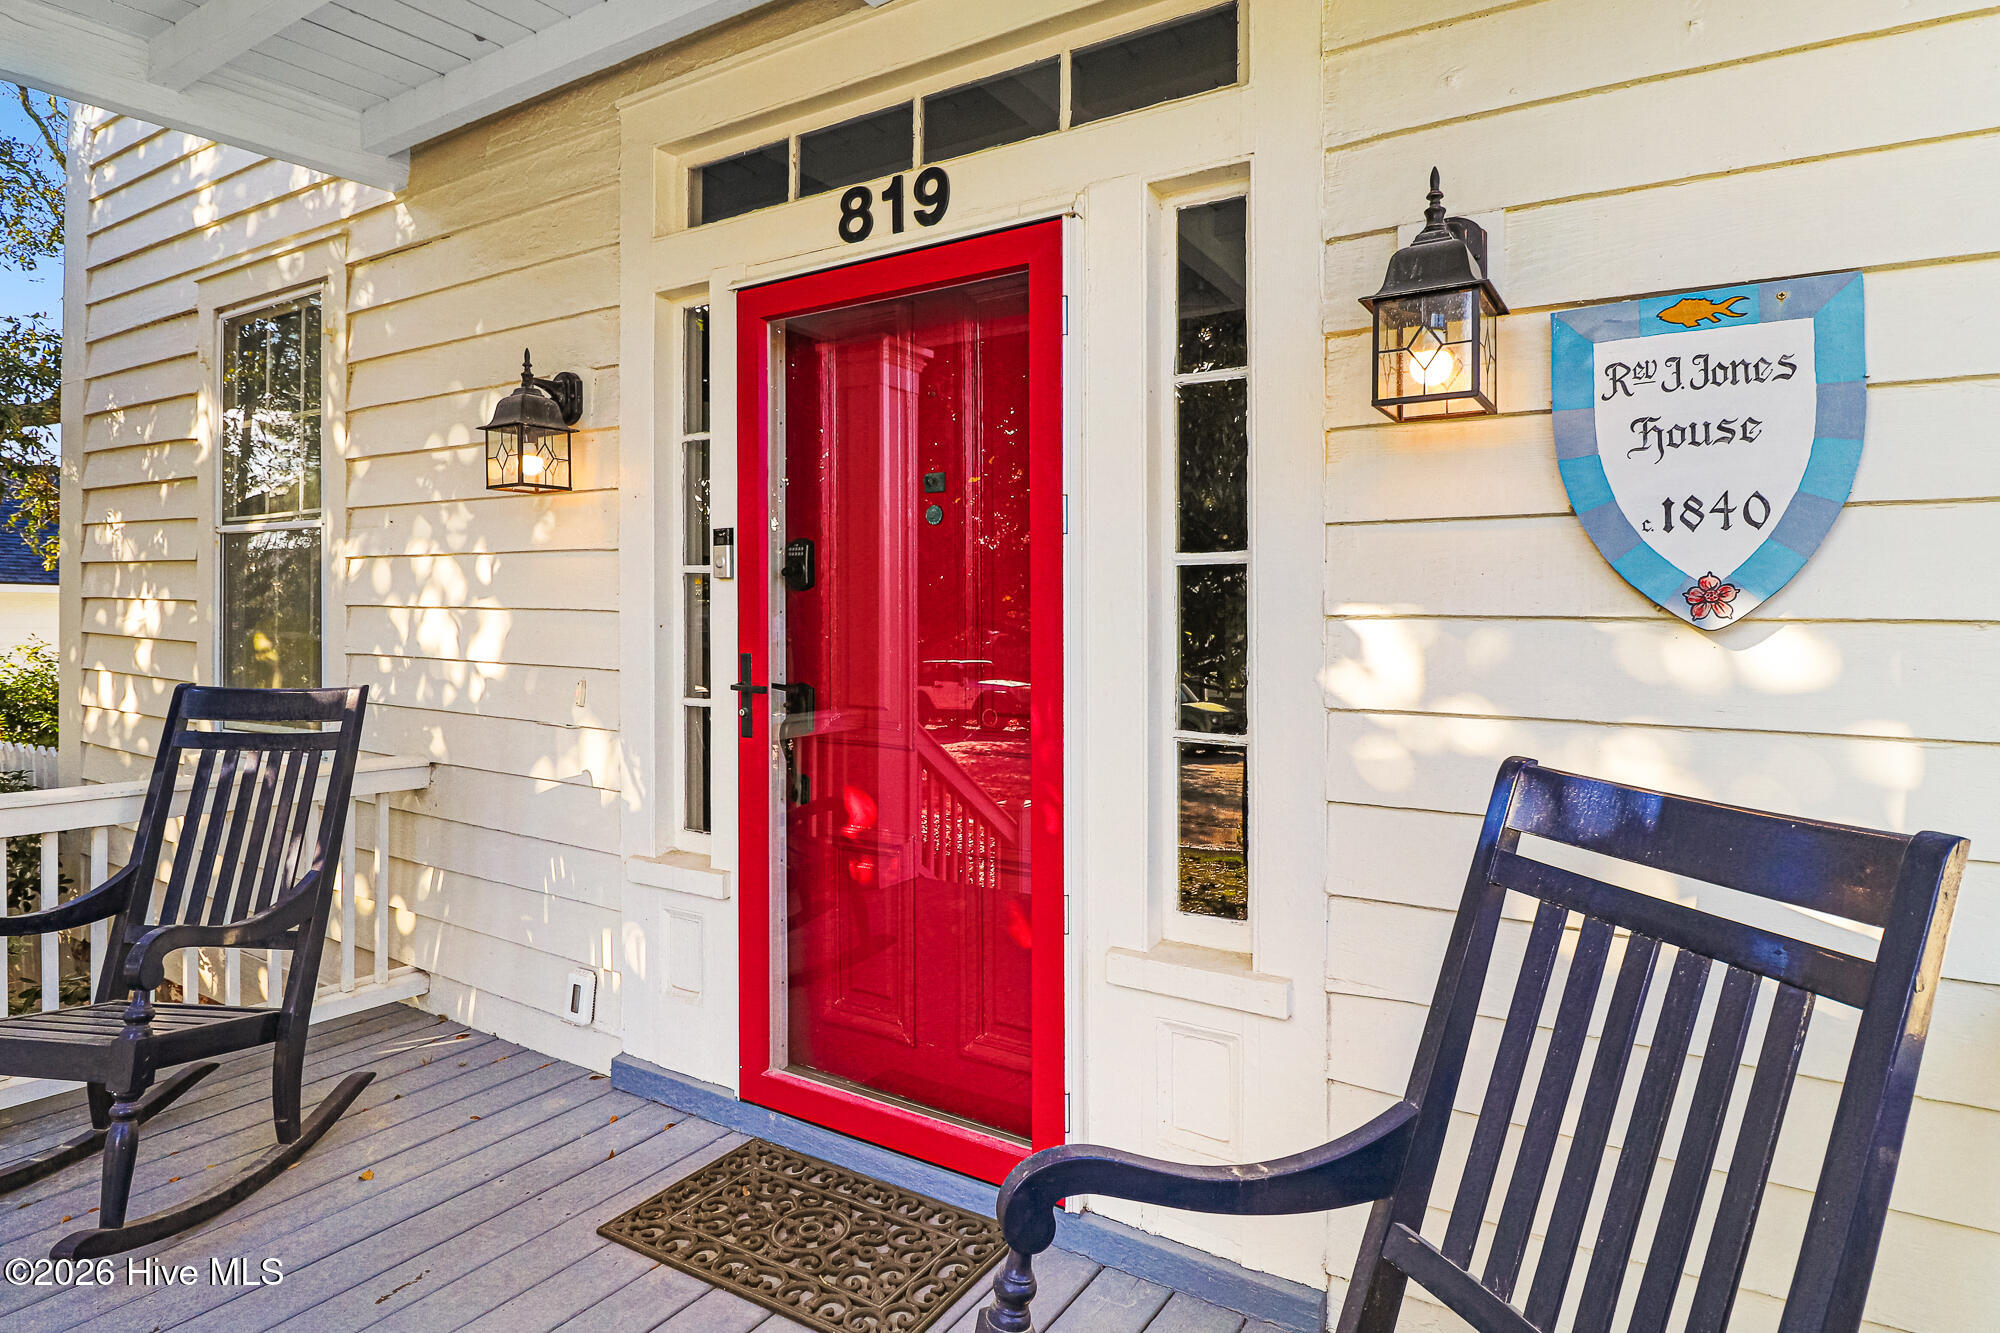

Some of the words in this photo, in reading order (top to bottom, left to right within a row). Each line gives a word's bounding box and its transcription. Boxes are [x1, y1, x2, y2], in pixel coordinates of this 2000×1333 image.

[838, 166, 951, 243] 819
[1601, 359, 1658, 401] Rev
[1689, 353, 1798, 391] Jones
[1627, 416, 1763, 464] House
